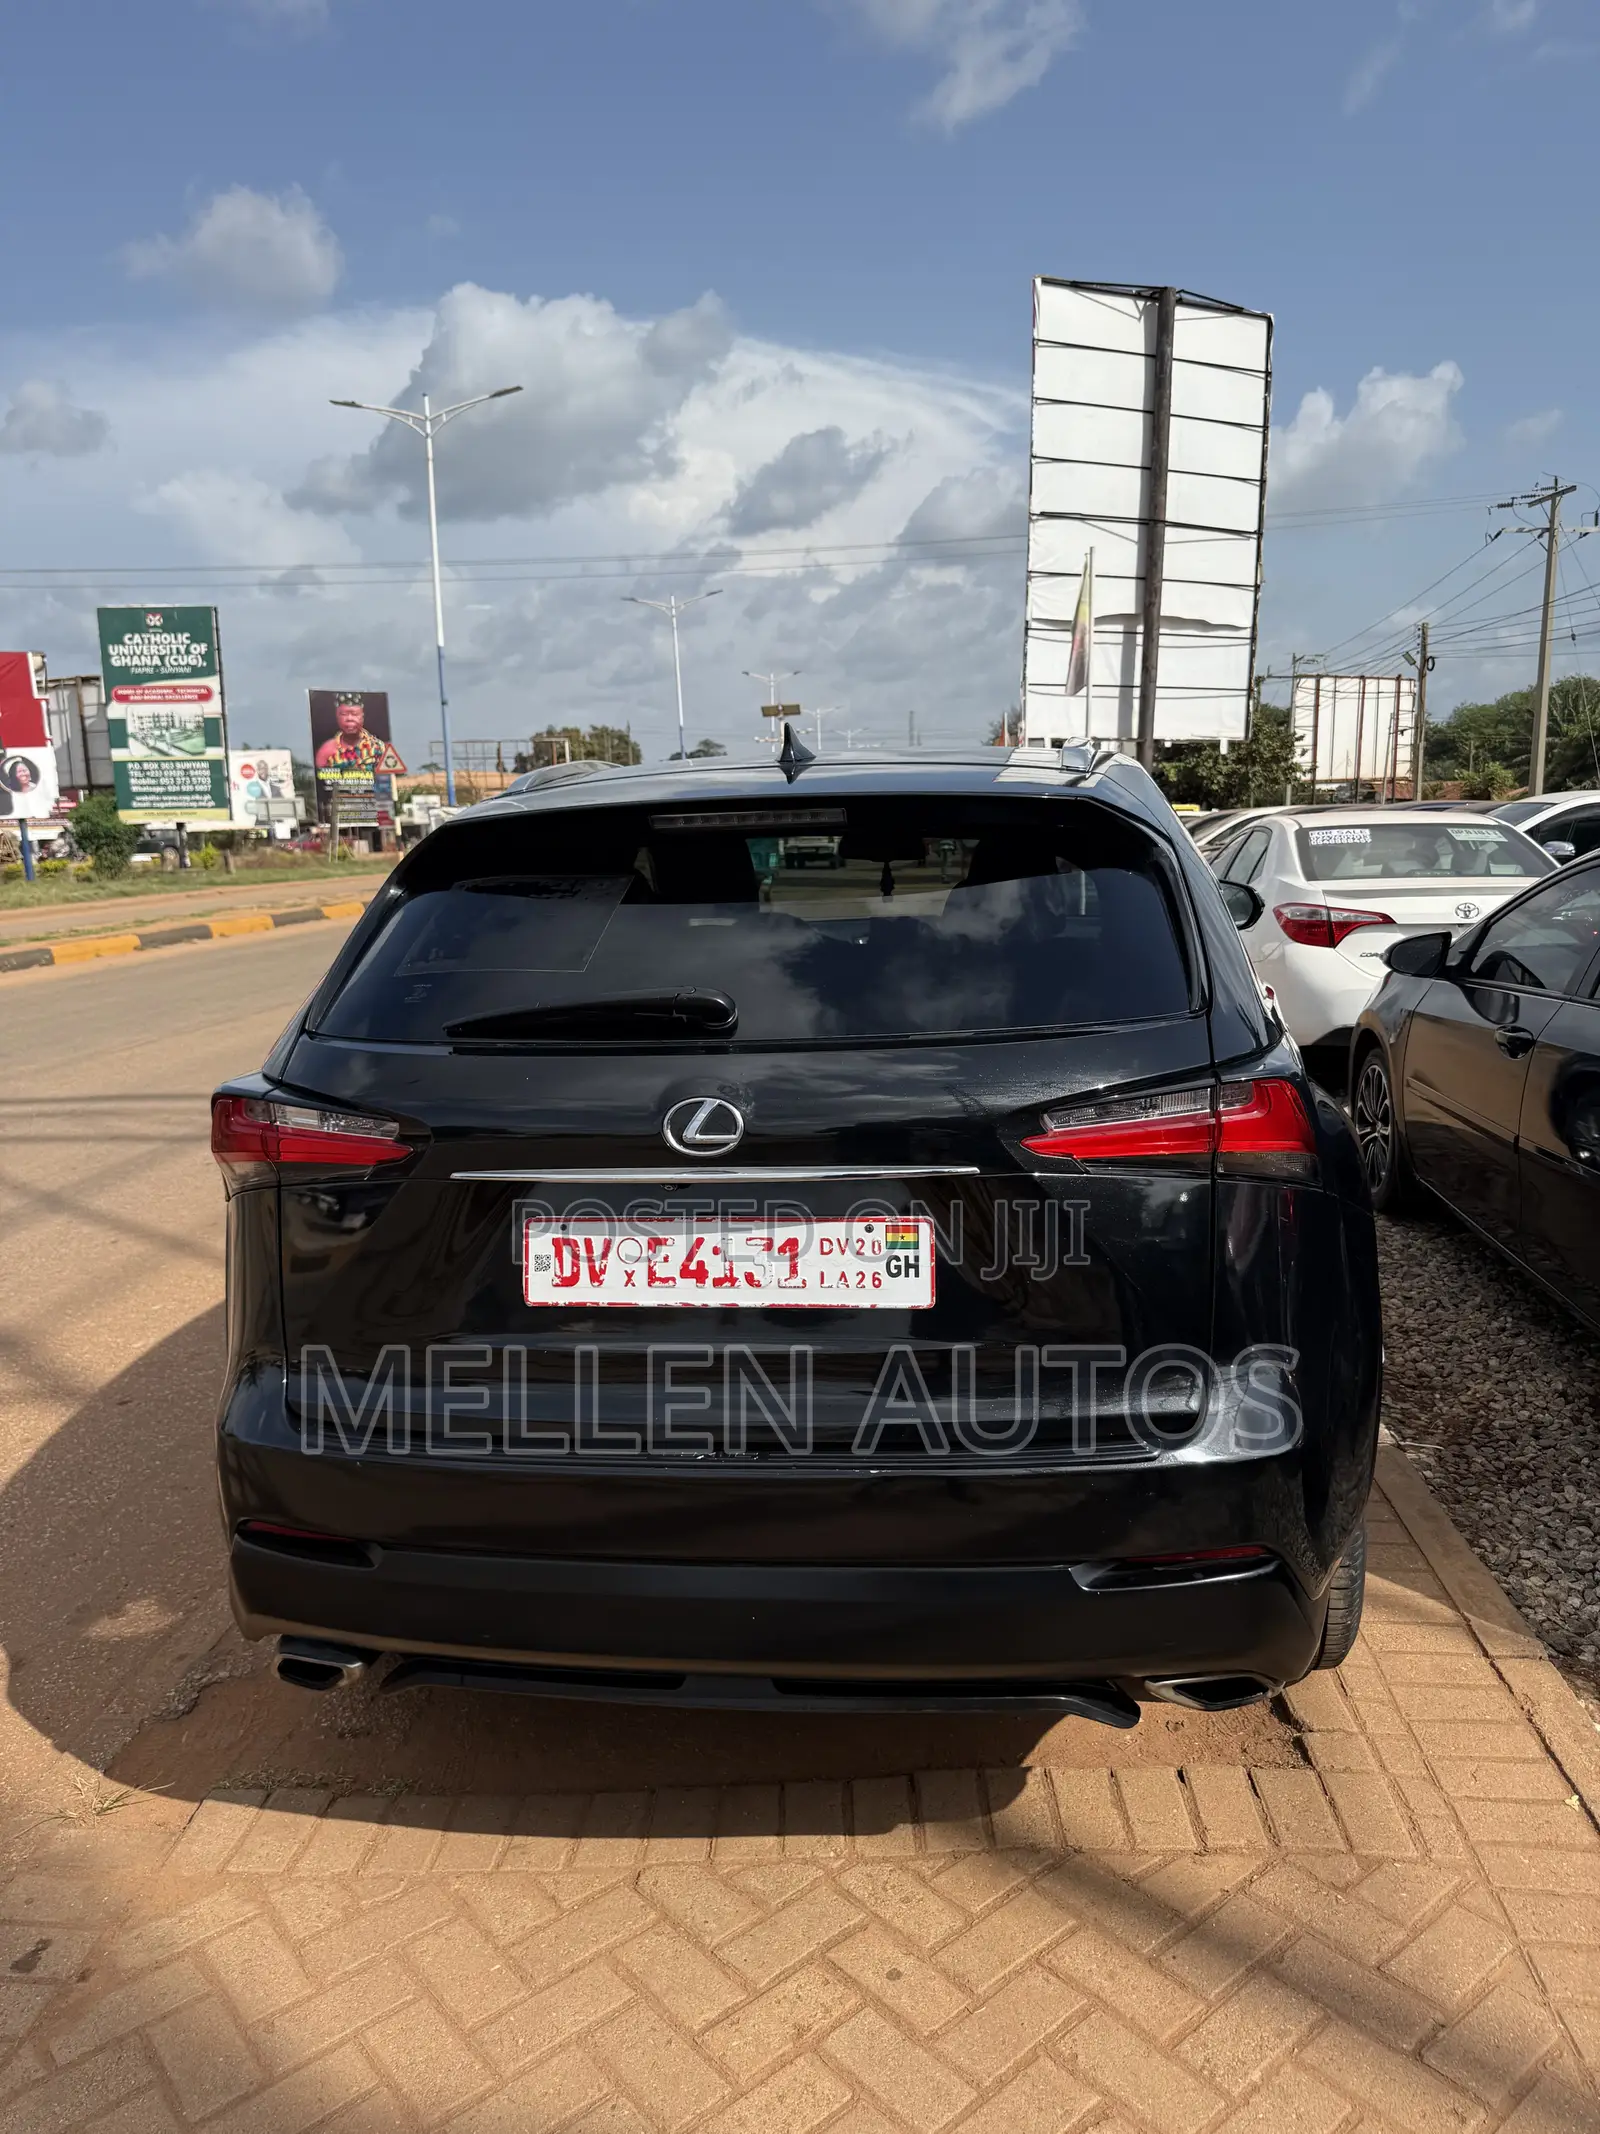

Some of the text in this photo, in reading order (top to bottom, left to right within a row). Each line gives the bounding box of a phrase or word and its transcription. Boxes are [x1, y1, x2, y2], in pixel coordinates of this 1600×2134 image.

[123, 632, 191, 645] CATHOLIC
[108, 643, 208, 656] UNIVERSITY OF
[110, 655, 162, 667] GHANA
[551, 1236, 613, 1288] DV
[885, 1254, 920, 1279] GH
